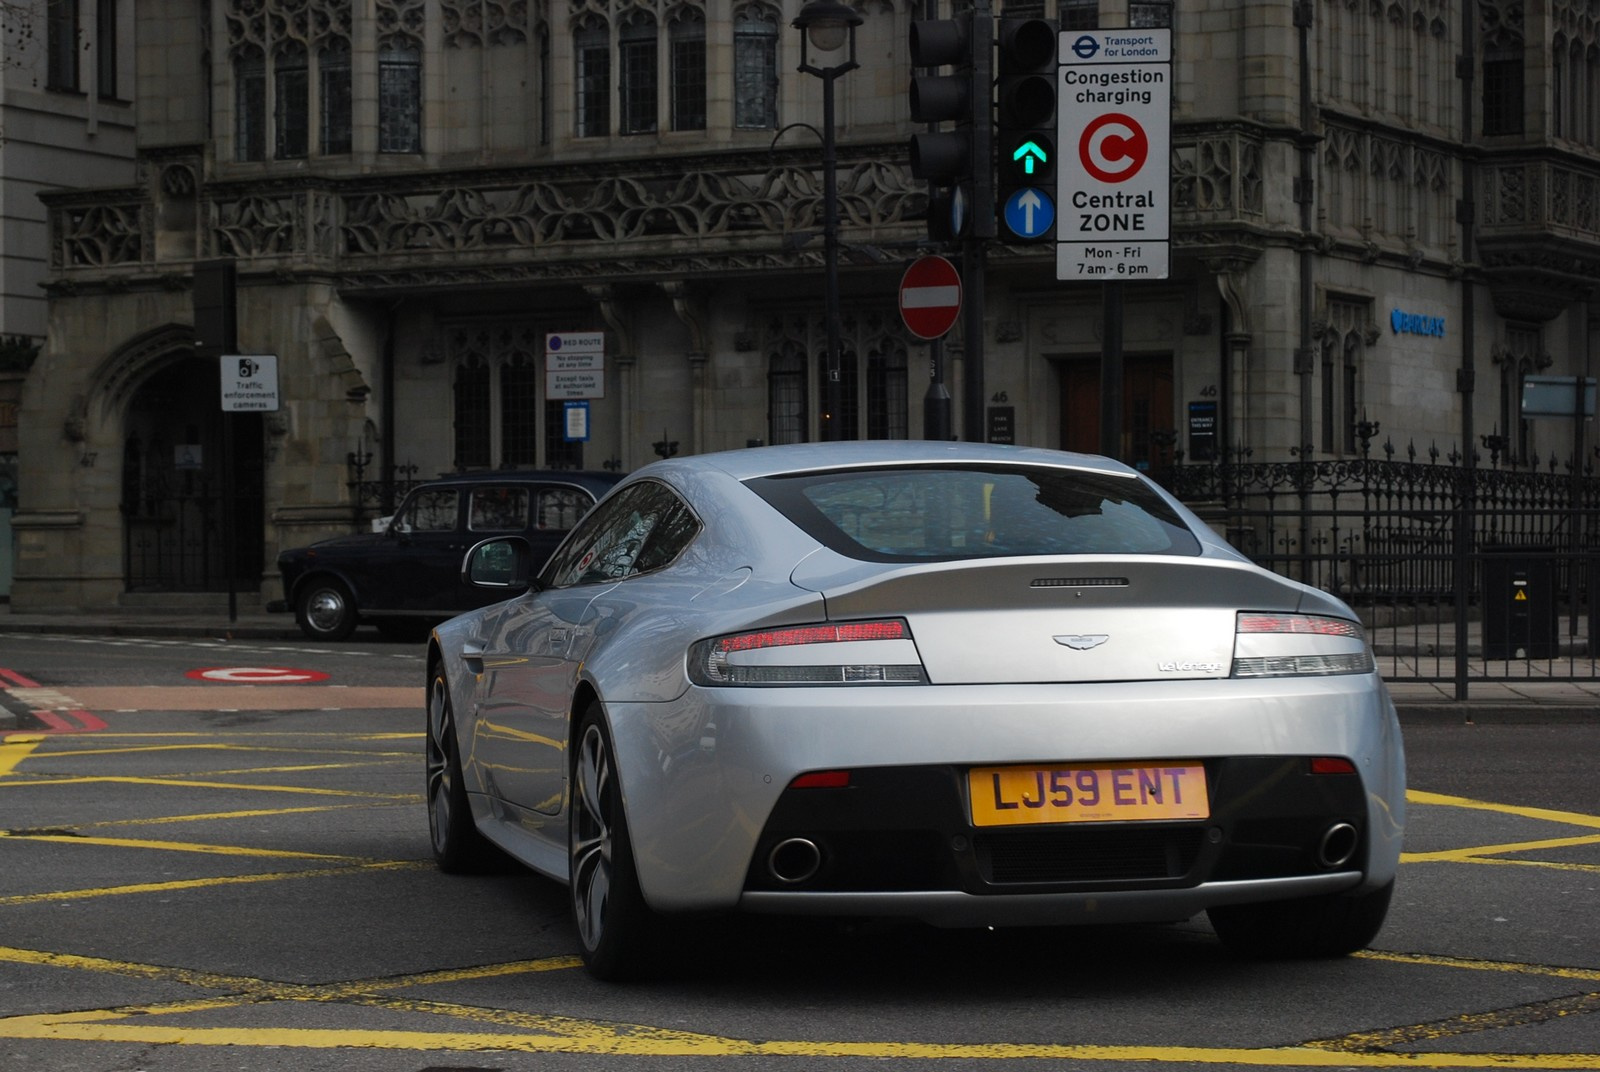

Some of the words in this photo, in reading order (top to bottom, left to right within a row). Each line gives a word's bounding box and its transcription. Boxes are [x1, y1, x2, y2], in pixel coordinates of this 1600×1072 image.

[1105, 37, 1153, 46] Transport
[1105, 48, 1118, 56] for
[1121, 47, 1158, 56] London
[1065, 69, 1163, 86] Congestion
[1076, 88, 1151, 105] charging
[1072, 190, 1154, 208] Central
[1080, 214, 1145, 231] ZONE
[1085, 247, 1112, 258] Mon
[1124, 247, 1141, 257] Fri
[579, 338, 601, 346] ROUTE
[236, 381, 263, 389] Traffic
[1200, 385, 1216, 397] 46
[224, 391, 276, 399] enforcement
[991, 391, 1008, 403] 46
[992, 769, 1100, 810] LJ59
[1111, 767, 1186, 806] ENT
